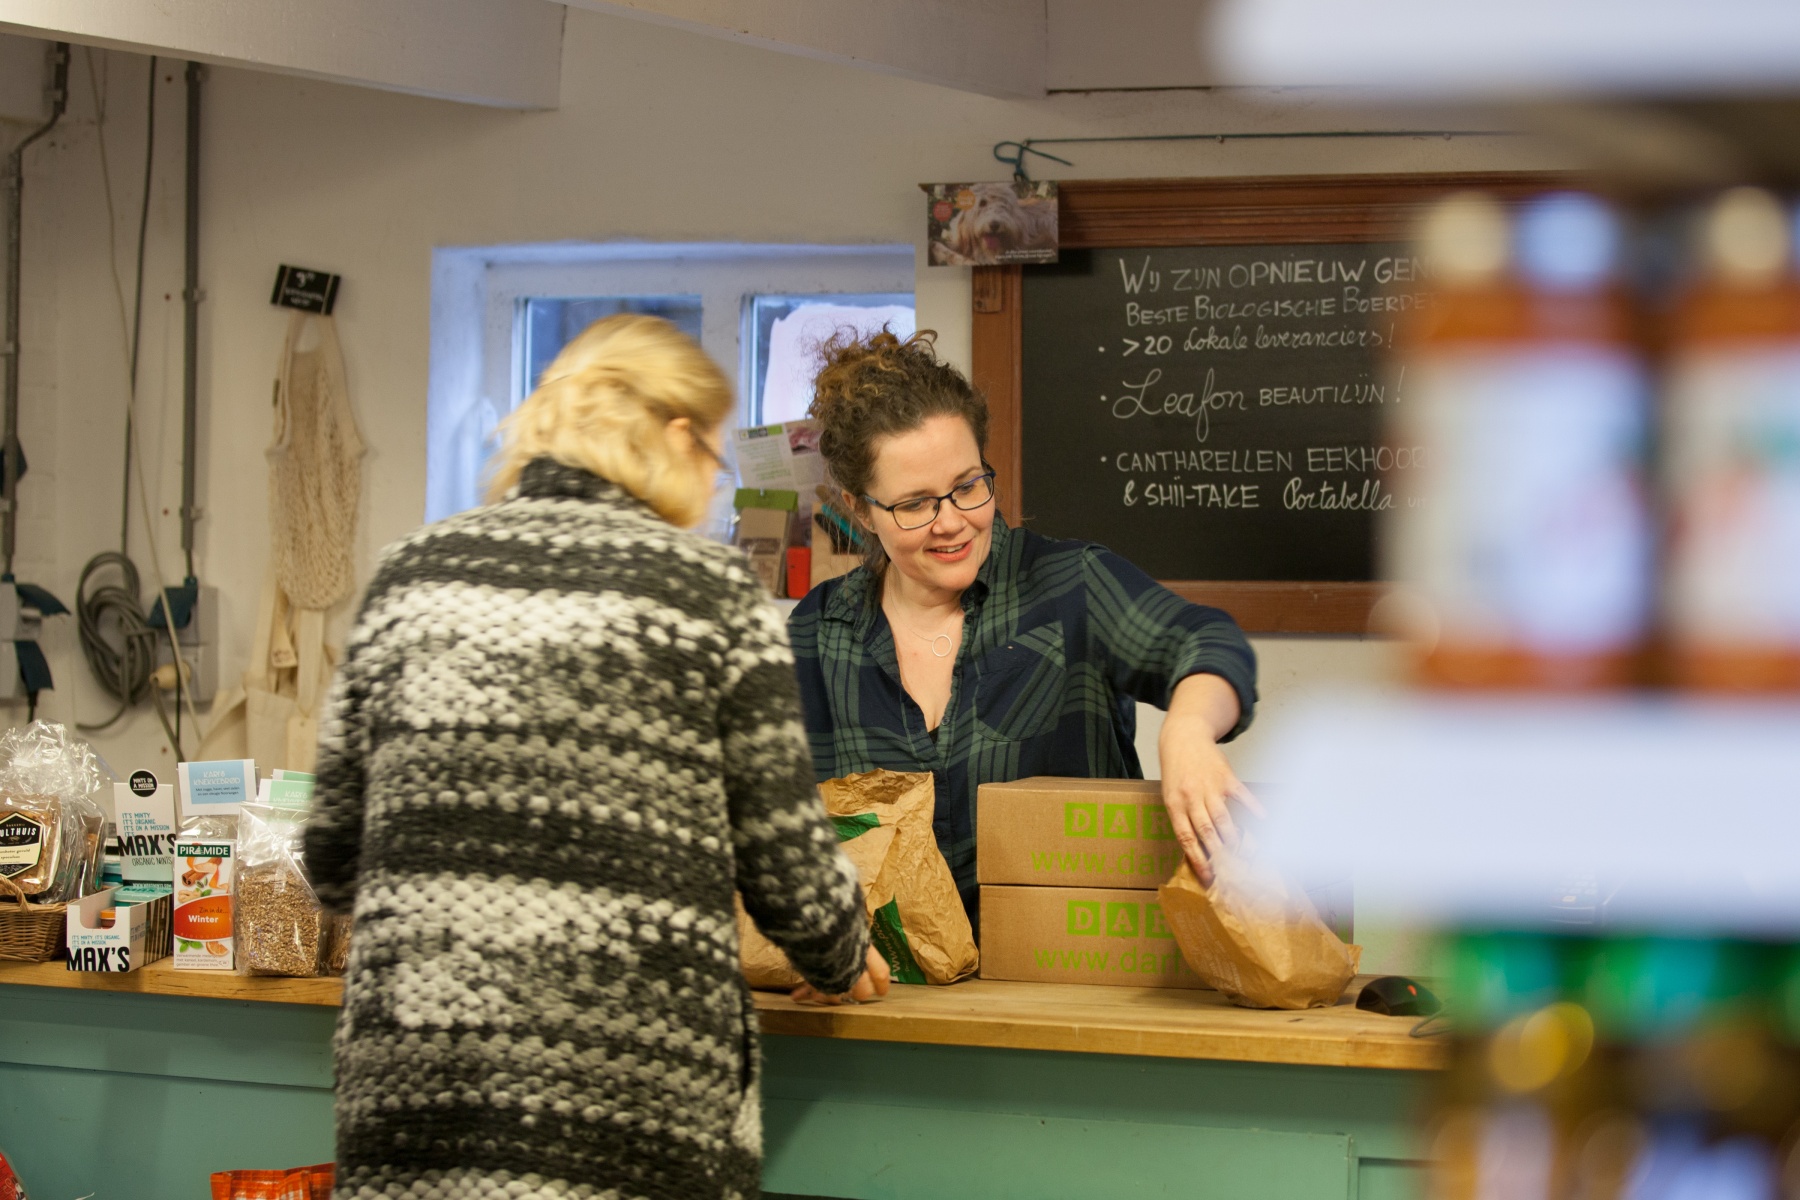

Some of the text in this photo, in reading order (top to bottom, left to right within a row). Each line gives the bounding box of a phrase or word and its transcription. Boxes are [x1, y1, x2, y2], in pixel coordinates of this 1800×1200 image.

[1228, 254, 1367, 289] OPNIEUW
[1373, 256, 1436, 285] GEN
[1125, 301, 1190, 327] BESTE
[1194, 294, 1337, 321] BIOLOGISCHE
[1115, 445, 1430, 474] CANTHARELLEN EEKHOOR
[1123, 478, 1139, 507] &
[1282, 475, 1398, 512] Portabella
[1068, 805, 1176, 838] DAR
[117, 833, 177, 857] MAX'S
[131, 856, 156, 867] ORGANIC
[1031, 848, 1180, 878] www.darf
[187, 914, 219, 924] Winter
[1071, 903, 1172, 937] DAR
[66, 946, 130, 973] MAX'S
